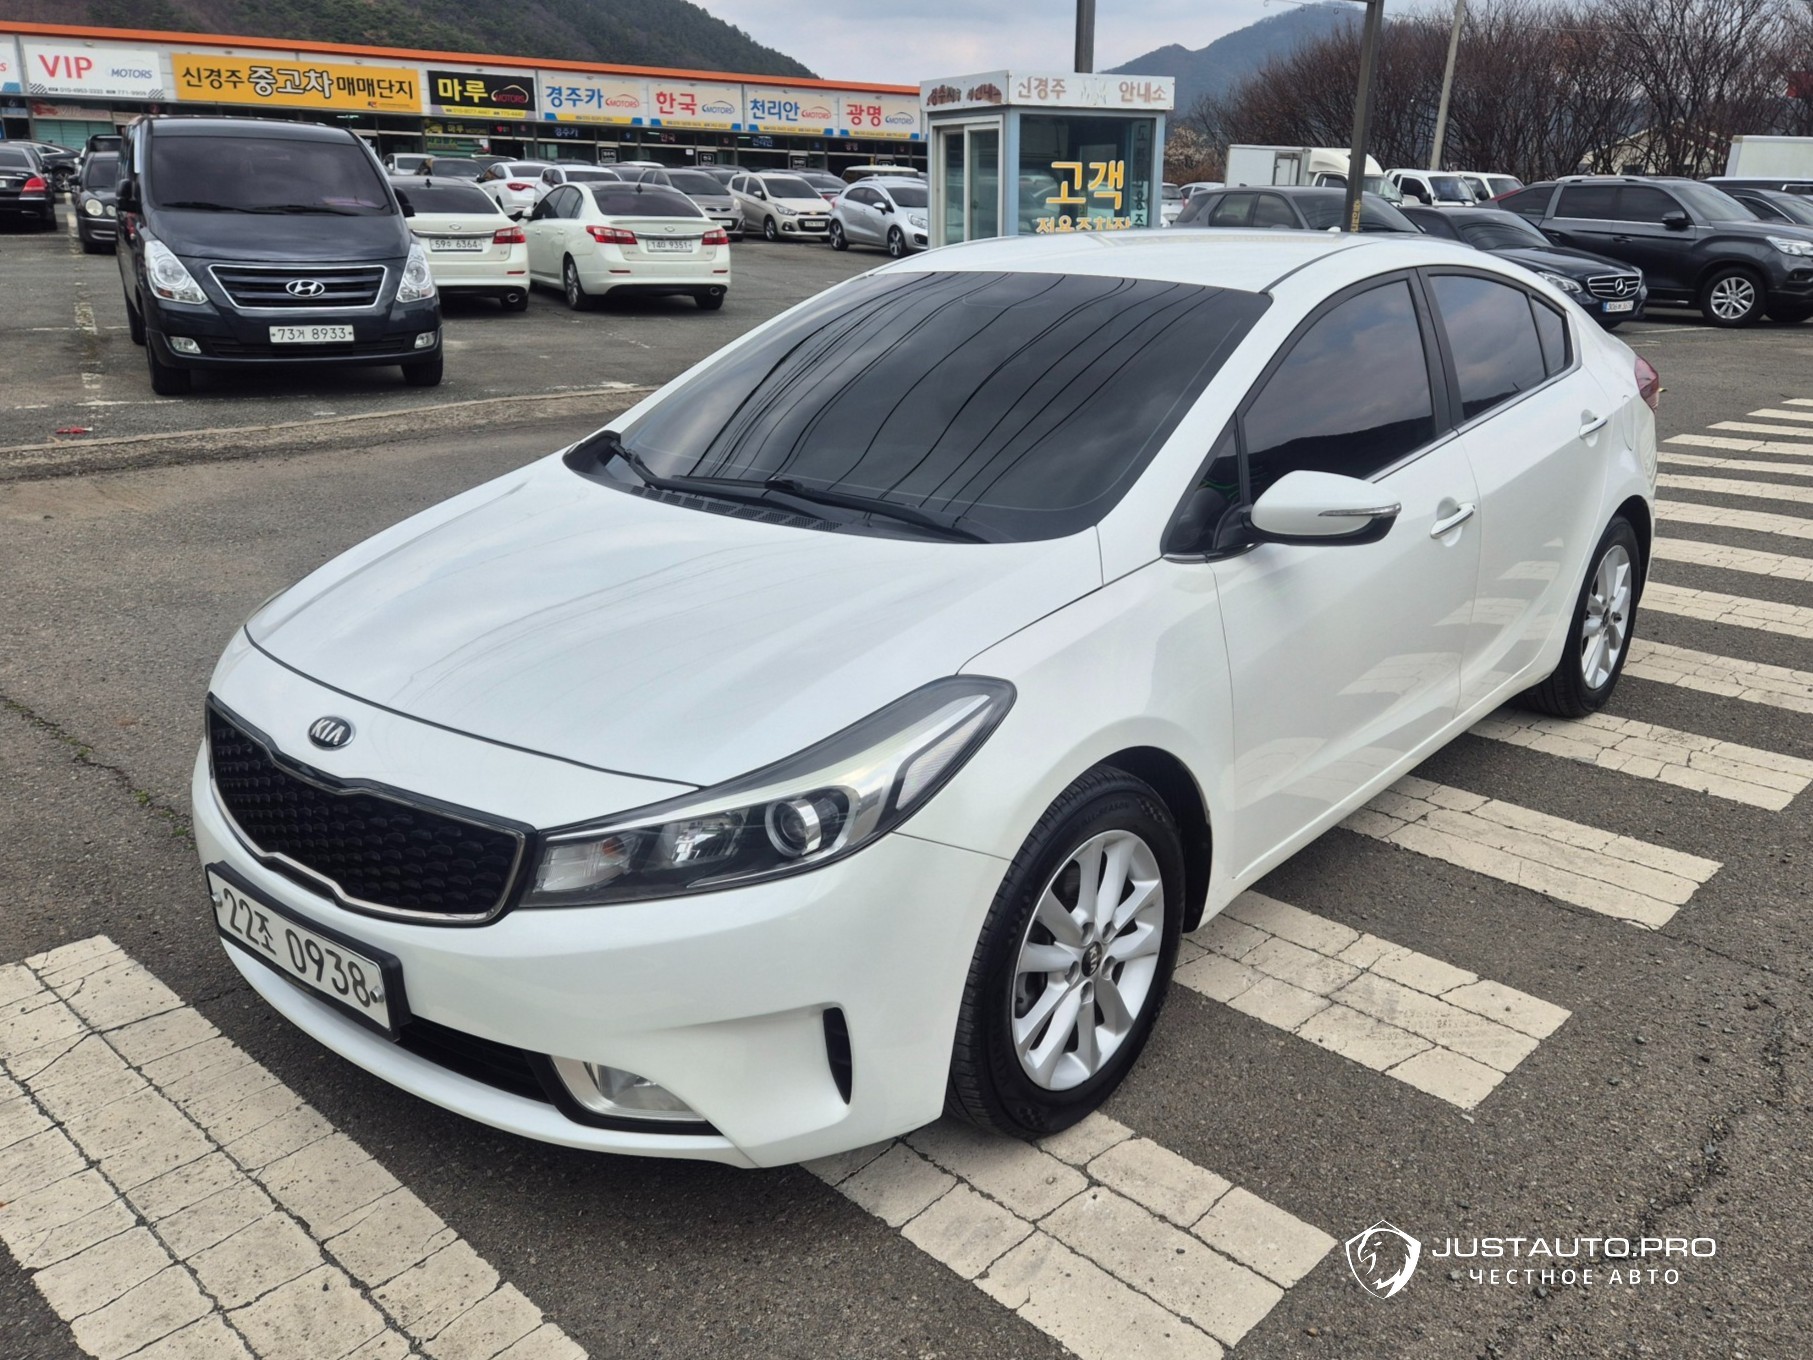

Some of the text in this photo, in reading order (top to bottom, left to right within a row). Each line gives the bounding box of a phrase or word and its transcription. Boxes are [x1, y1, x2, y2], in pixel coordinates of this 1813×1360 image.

[38, 54, 92, 79] VIP
[111, 68, 152, 79] MOTORS
[182, 65, 413, 100] 신경주 중고차 매매단지
[437, 78, 488, 103] 마루
[1017, 76, 1066, 100] 신경주
[1119, 80, 1166, 103] 안내소
[545, 86, 604, 109] 경주카
[609, 100, 638, 108] MOTORS
[656, 91, 697, 116] 한국
[706, 106, 734, 114] MOTORS
[750, 98, 800, 121] 천리안
[805, 111, 830, 119] MOTORS
[846, 104, 881, 127] 광명
[888, 117, 914, 125] MOTORS
[1045, 159, 1125, 210] 고객
[311, 327, 346, 340] 8933
[310, 718, 346, 746] KIA
[222, 887, 371, 1008] 22조 0938
